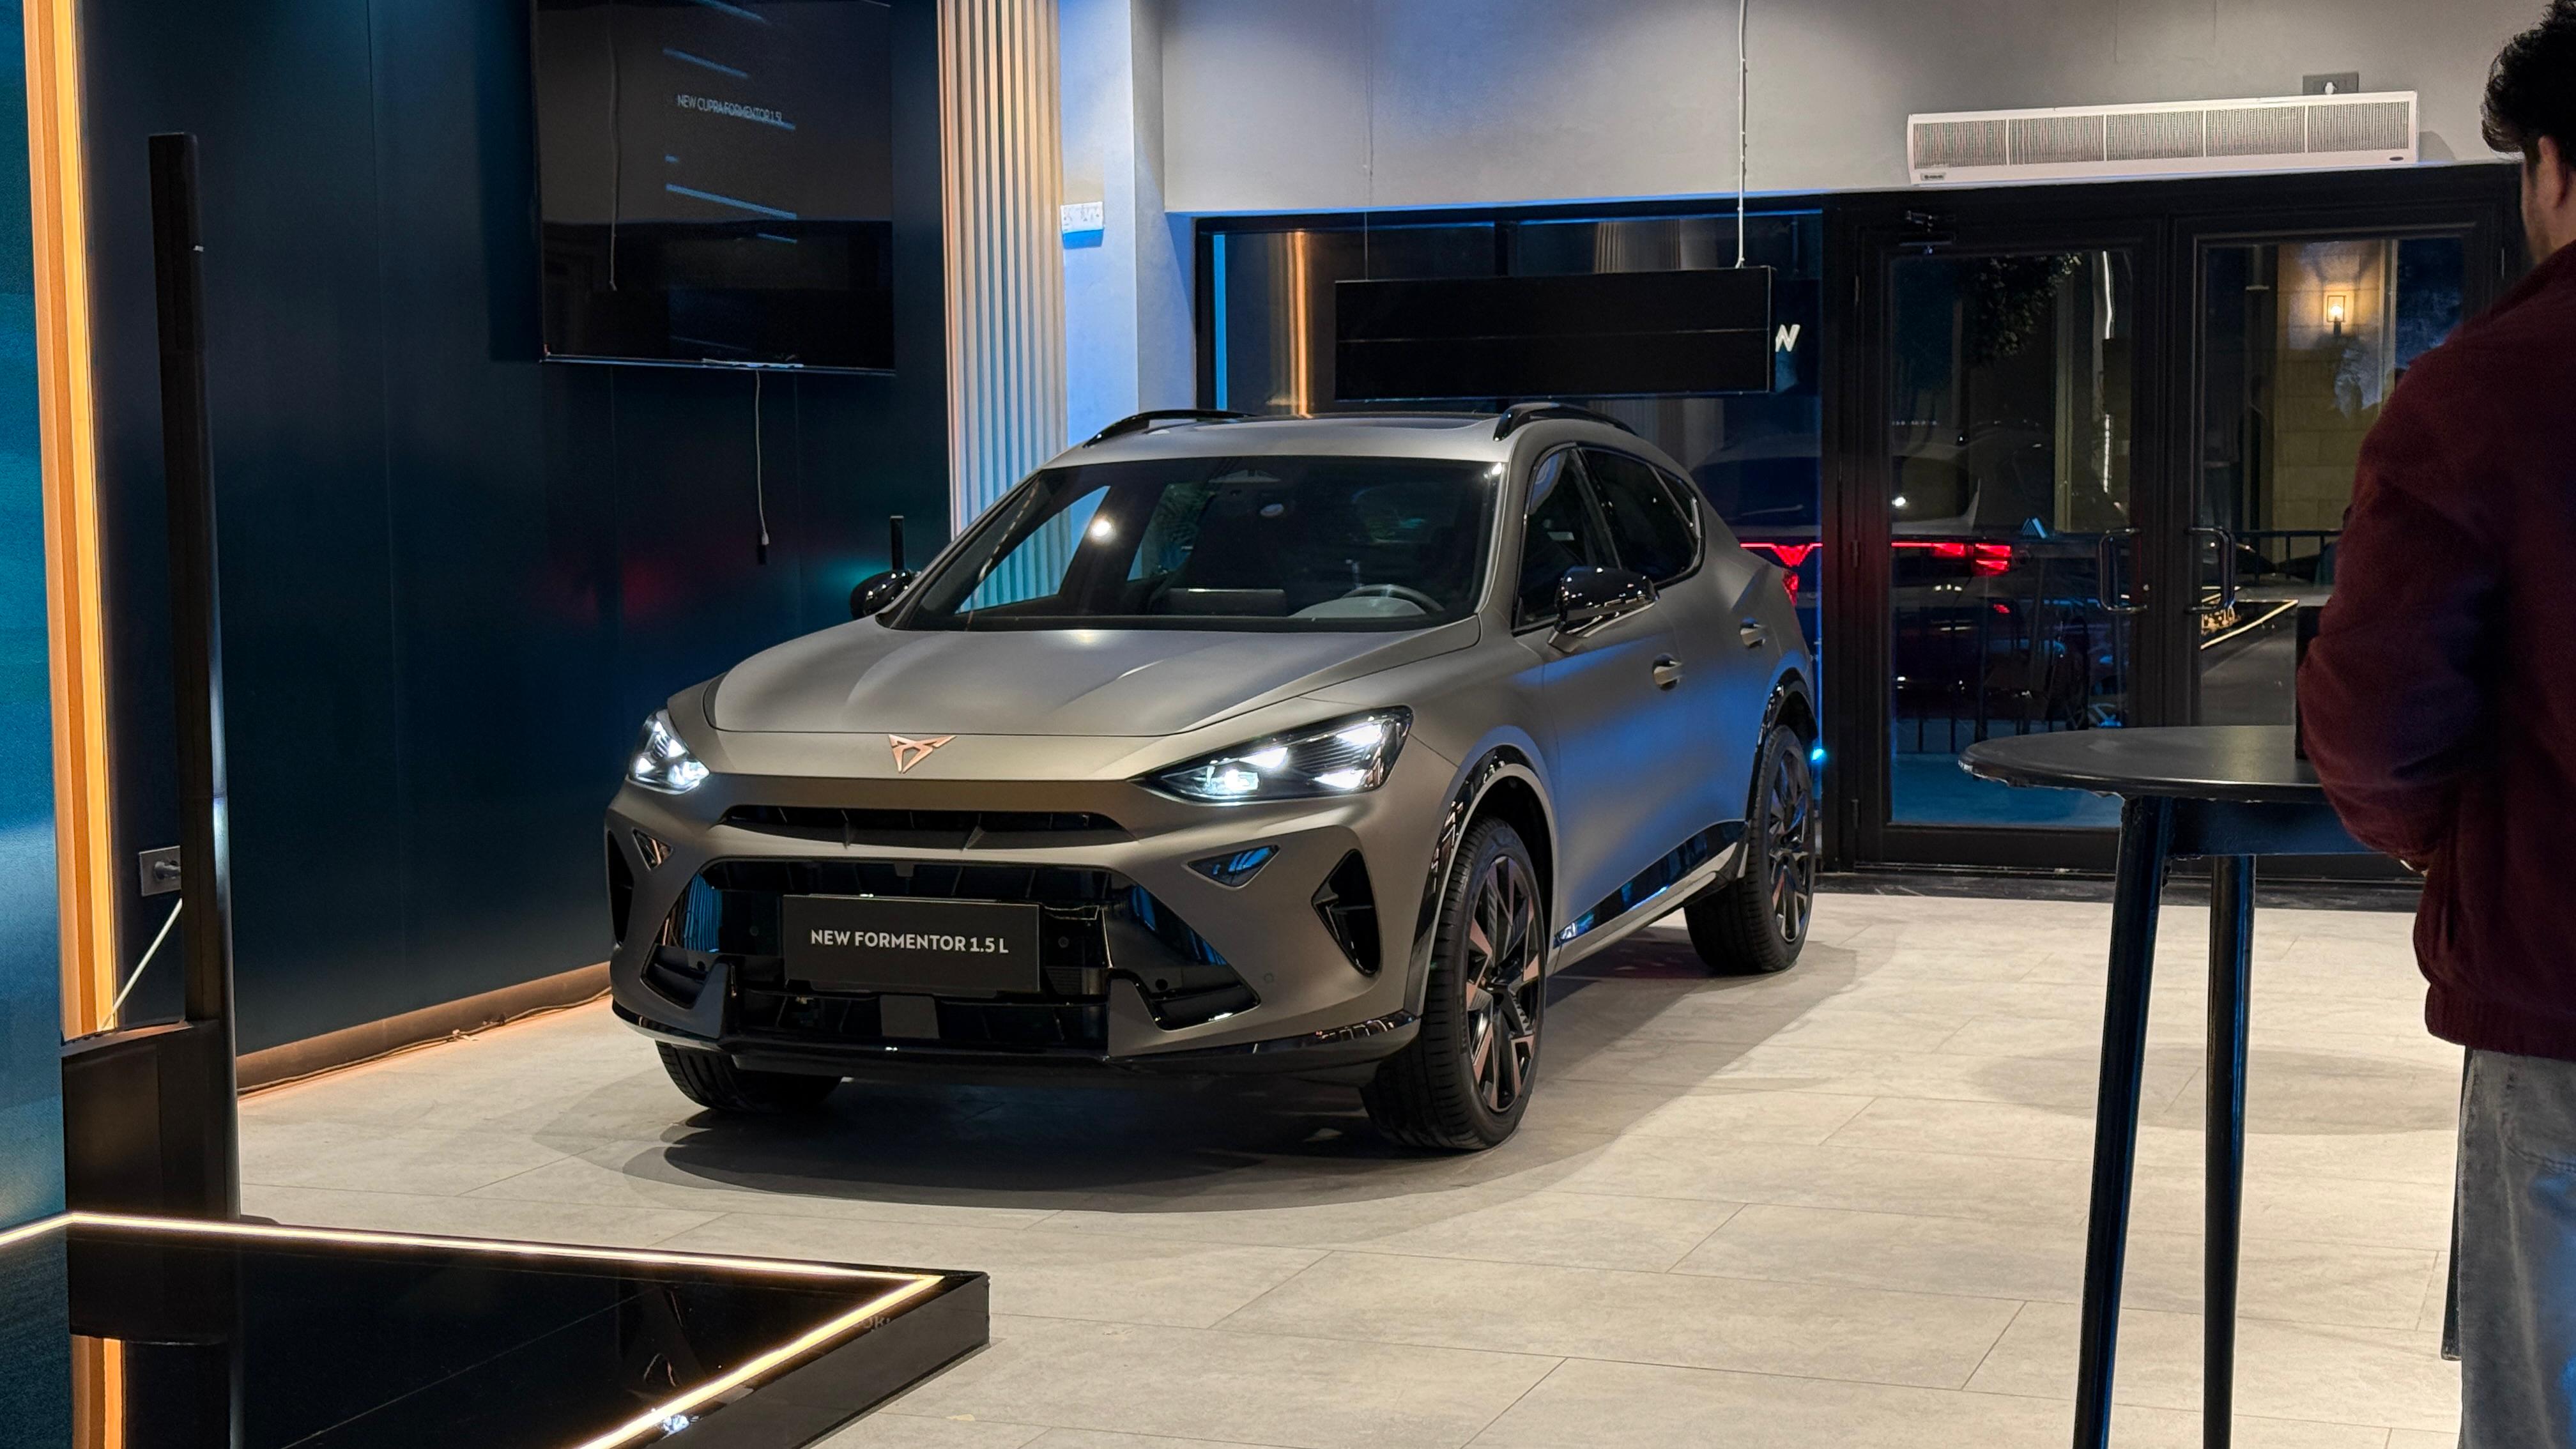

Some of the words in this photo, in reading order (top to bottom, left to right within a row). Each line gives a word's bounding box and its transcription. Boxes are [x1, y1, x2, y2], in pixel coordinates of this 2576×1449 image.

[677, 95, 696, 109] NEW
[697, 98, 723, 114] CUPRA
[810, 929, 850, 946] NEW
[855, 931, 966, 952] FORMENTOR
[970, 937, 995, 953] 1.5
[999, 938, 1009, 954] L
